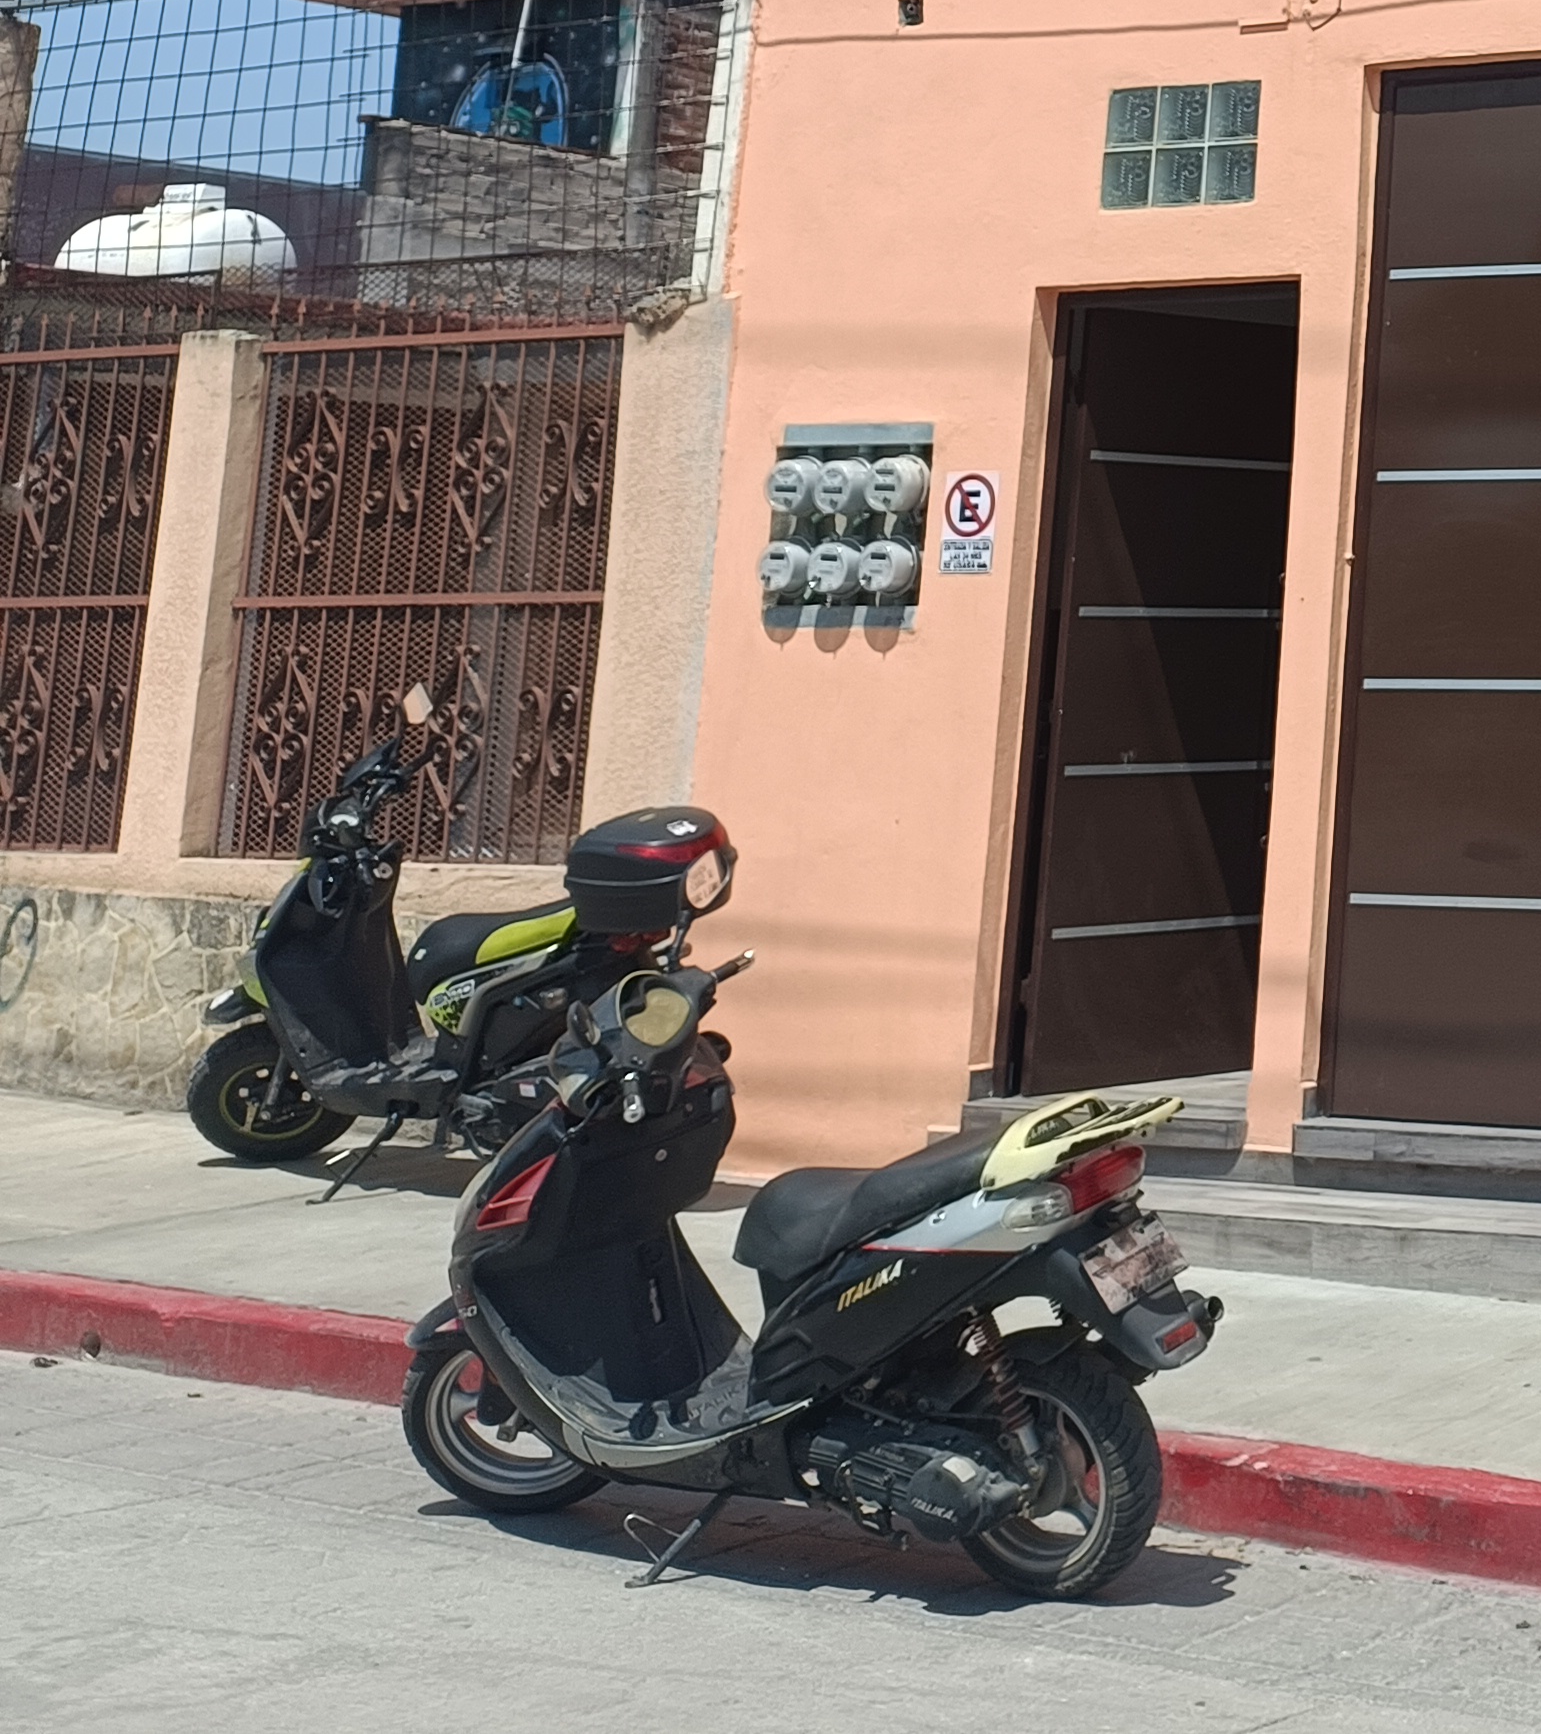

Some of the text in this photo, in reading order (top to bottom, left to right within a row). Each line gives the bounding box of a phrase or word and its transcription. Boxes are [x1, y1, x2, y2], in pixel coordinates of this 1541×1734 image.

[959, 490, 981, 522] E
[837, 1258, 904, 1312] ITALIKA
[911, 1497, 955, 1520] ITALIKA
